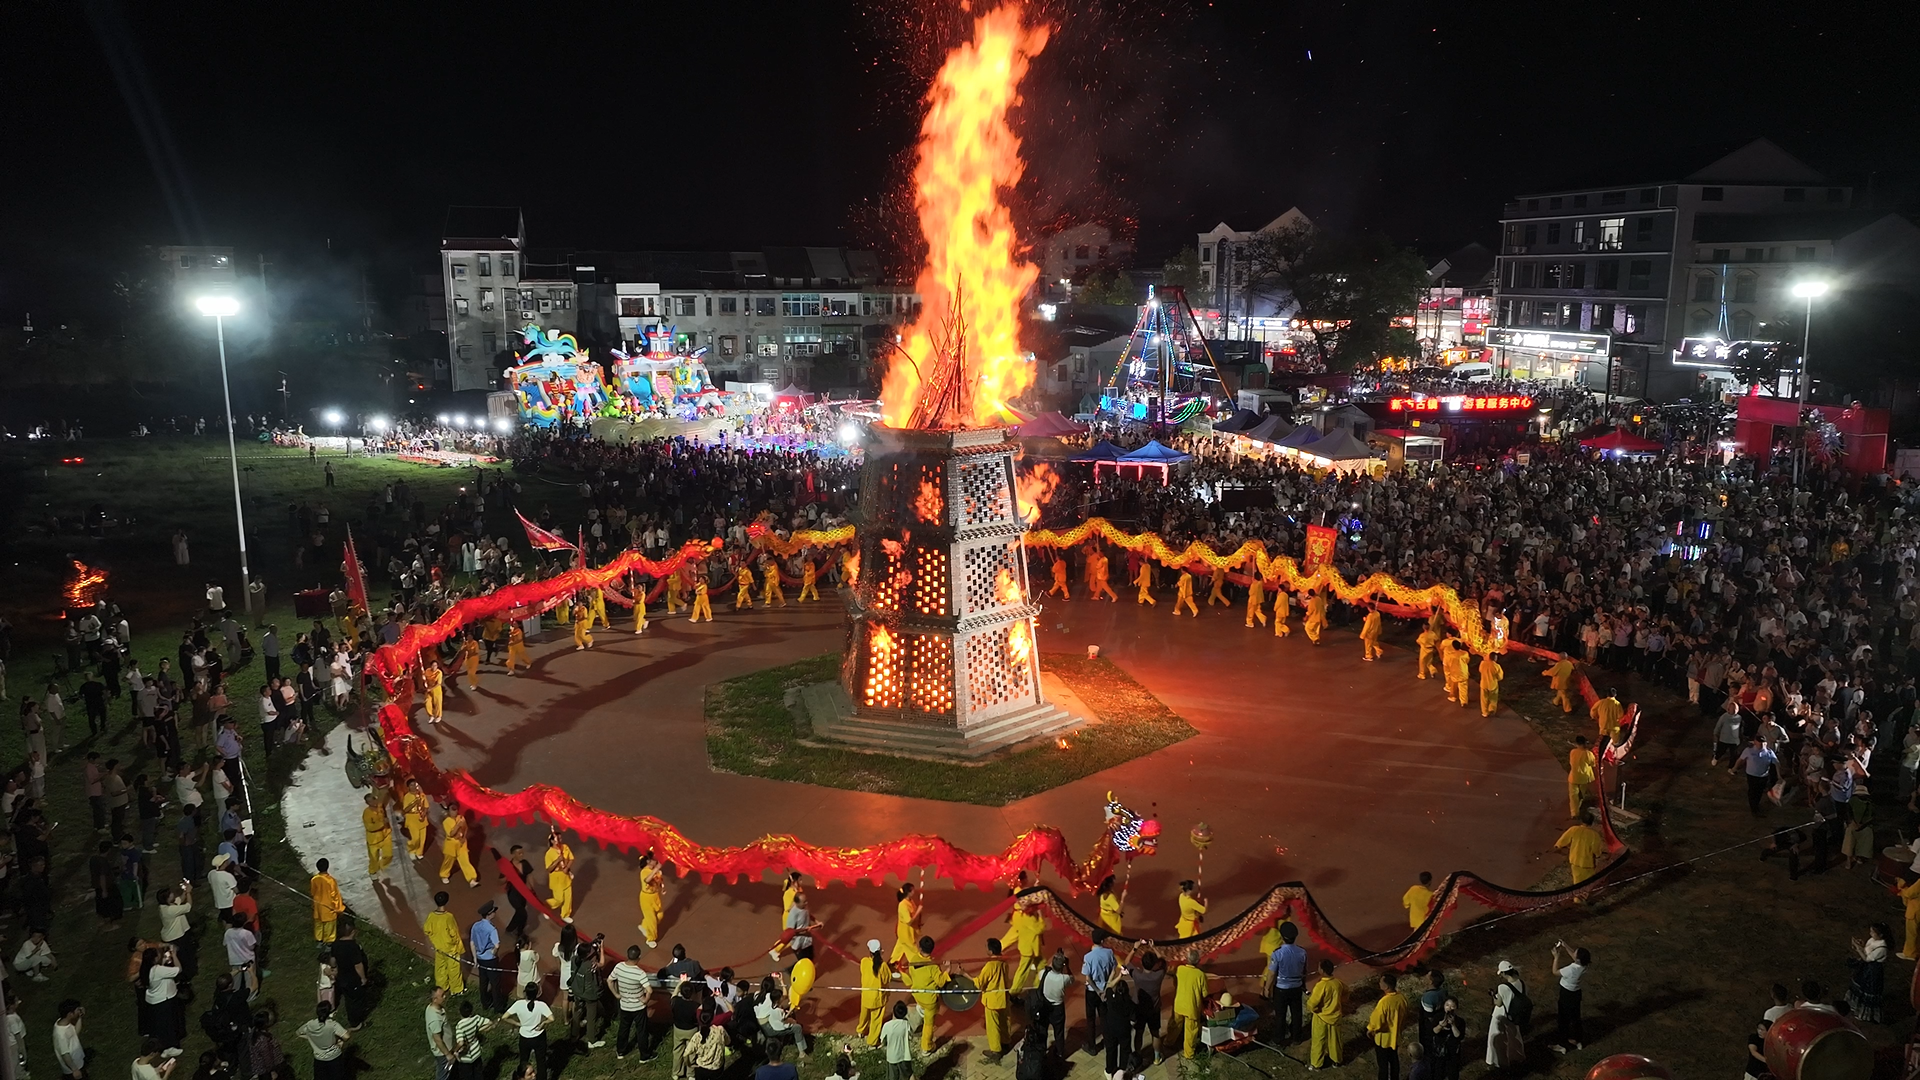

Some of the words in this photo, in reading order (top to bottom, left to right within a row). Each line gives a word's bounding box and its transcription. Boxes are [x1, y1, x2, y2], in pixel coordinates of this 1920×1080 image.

[1463, 397, 1531, 409] 游客服务中心
